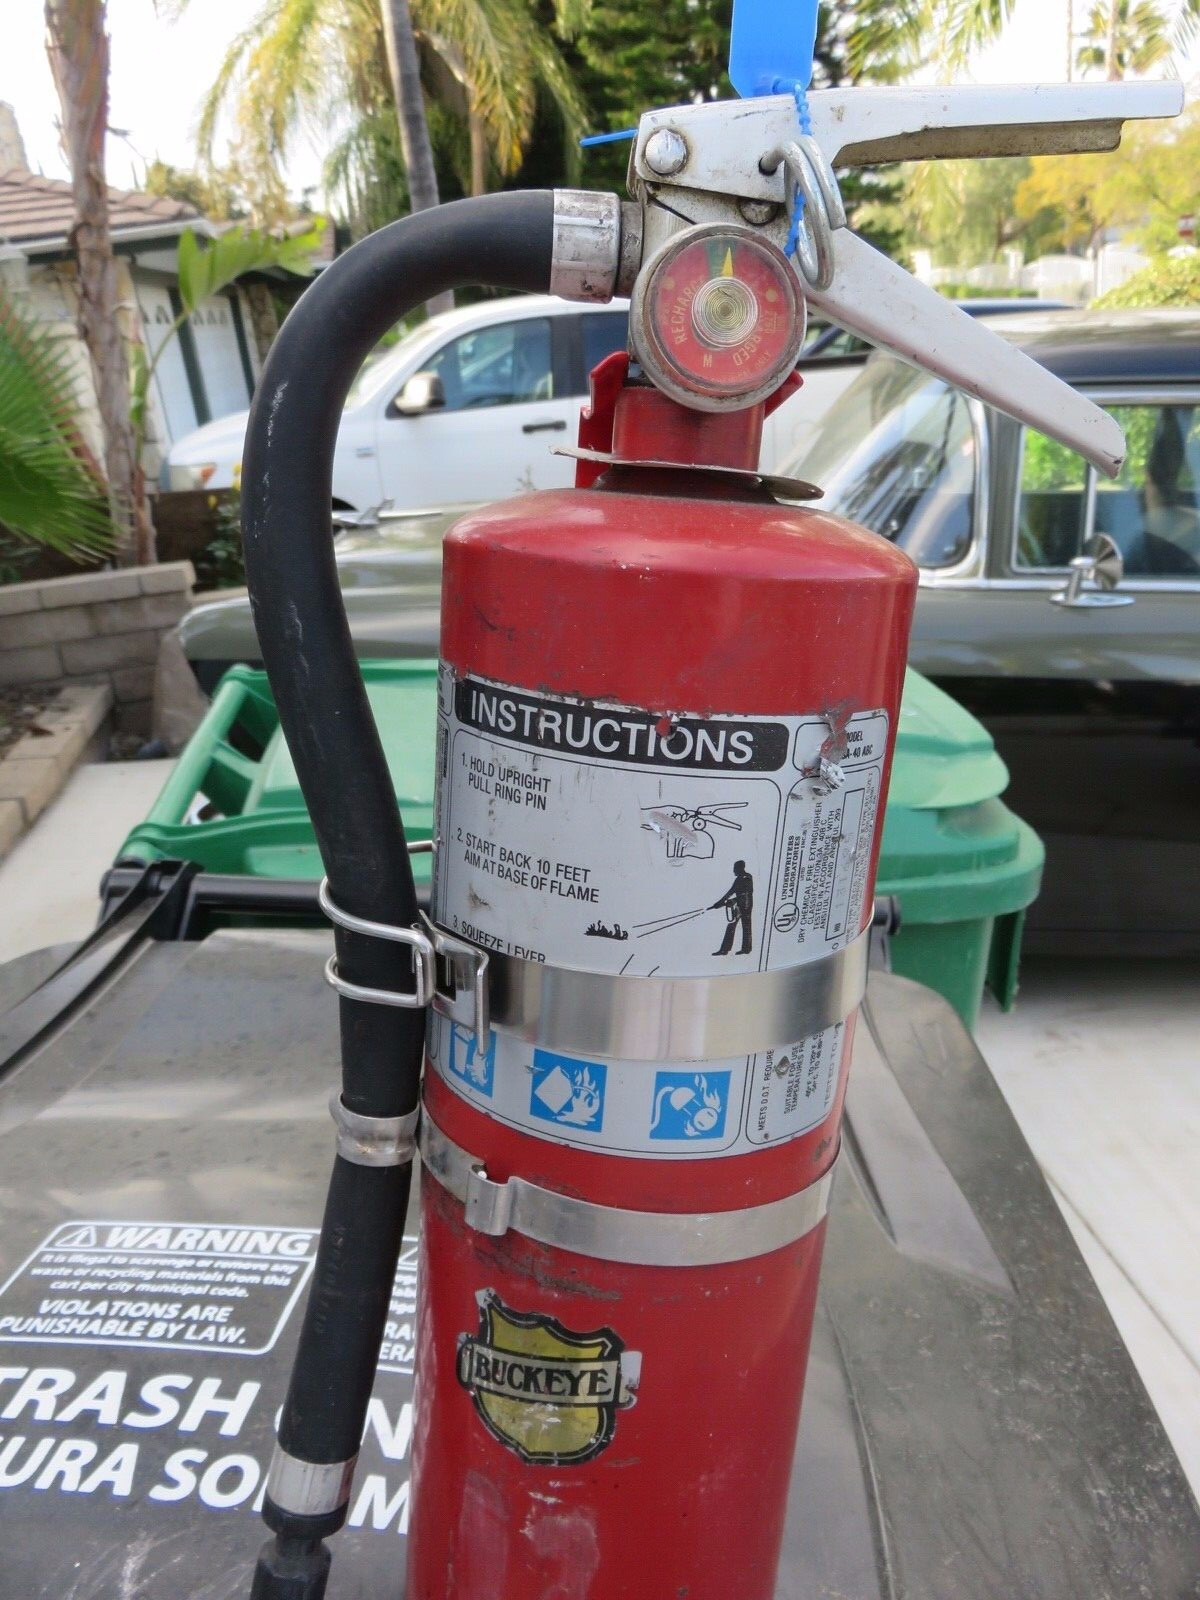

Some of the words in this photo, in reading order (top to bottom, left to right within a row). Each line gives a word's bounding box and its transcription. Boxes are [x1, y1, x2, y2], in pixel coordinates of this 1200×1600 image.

[471, 689, 754, 764] INSTRUCTIONS
[461, 752, 468, 767] 1.
[470, 755, 495, 777] HOLD
[498, 766, 552, 793] UPRIGHT
[468, 772, 491, 795] PULL
[495, 782, 521, 804] RING
[526, 792, 547, 811] PIN
[809, 802, 823, 862] EXTINGUISHER
[457, 828, 464, 843] 2.
[466, 833, 496, 858] START
[499, 847, 532, 870] BACK
[537, 859, 550, 875] 10
[556, 863, 591, 883] FEET
[781, 835, 795, 900] UNDERWRITERS
[788, 836, 801, 898] LABORATORIES
[806, 864, 815, 882] FIRE
[813, 901, 823, 930] TESTED
[818, 890, 824, 899] IN
[827, 810, 835, 832] WITH
[827, 861, 835, 878] AND
[464, 850, 480, 868] AIM
[482, 859, 496, 875] AT
[497, 863, 529, 887] BASE
[531, 875, 548, 891] OF
[550, 880, 600, 903] FLAME
[807, 859, 820, 925] CLASSIFICATION
[800, 885, 812, 926] CHEMICAL
[788, 1062, 796, 1078] FOR
[791, 1046, 799, 1061] USE
[758, 1106, 768, 1131] MEETS
[764, 1048, 774, 1081] REQUIRE
[784, 1079, 794, 1114] SUITABLE
[791, 1053, 804, 1112] TEMPERATURES
[105, 1226, 313, 1256] WARNING
[31, 1267, 73, 1276] waste
[73, 1268, 92, 1276] or
[90, 1268, 156, 1281] recycling
[155, 1270, 223, 1282] materials
[224, 1272, 261, 1284] from
[262, 1274, 292, 1287] this
[53, 1254, 66, 1263] is
[67, 1254, 112, 1266] illegal
[110, 1255, 127, 1264] to
[129, 1257, 195, 1269] scavenge
[195, 1260, 212, 1269] or
[213, 1261, 269, 1272] remove
[270, 1262, 299, 1275] any
[50, 1280, 80, 1290] cart
[78, 1281, 108, 1292] per
[106, 1281, 135, 1293] city
[134, 1282, 210, 1296] municipal
[209, 1285, 249, 1298] code.
[0, 1316, 146, 1338] PUNISHABLE
[146, 1320, 186, 1339] BY
[184, 1324, 247, 1345] LAW.
[38, 1299, 183, 1320] VIOLATIONS
[181, 1304, 234, 1323] ARE
[475, 1351, 612, 1396] BUCKEYE
